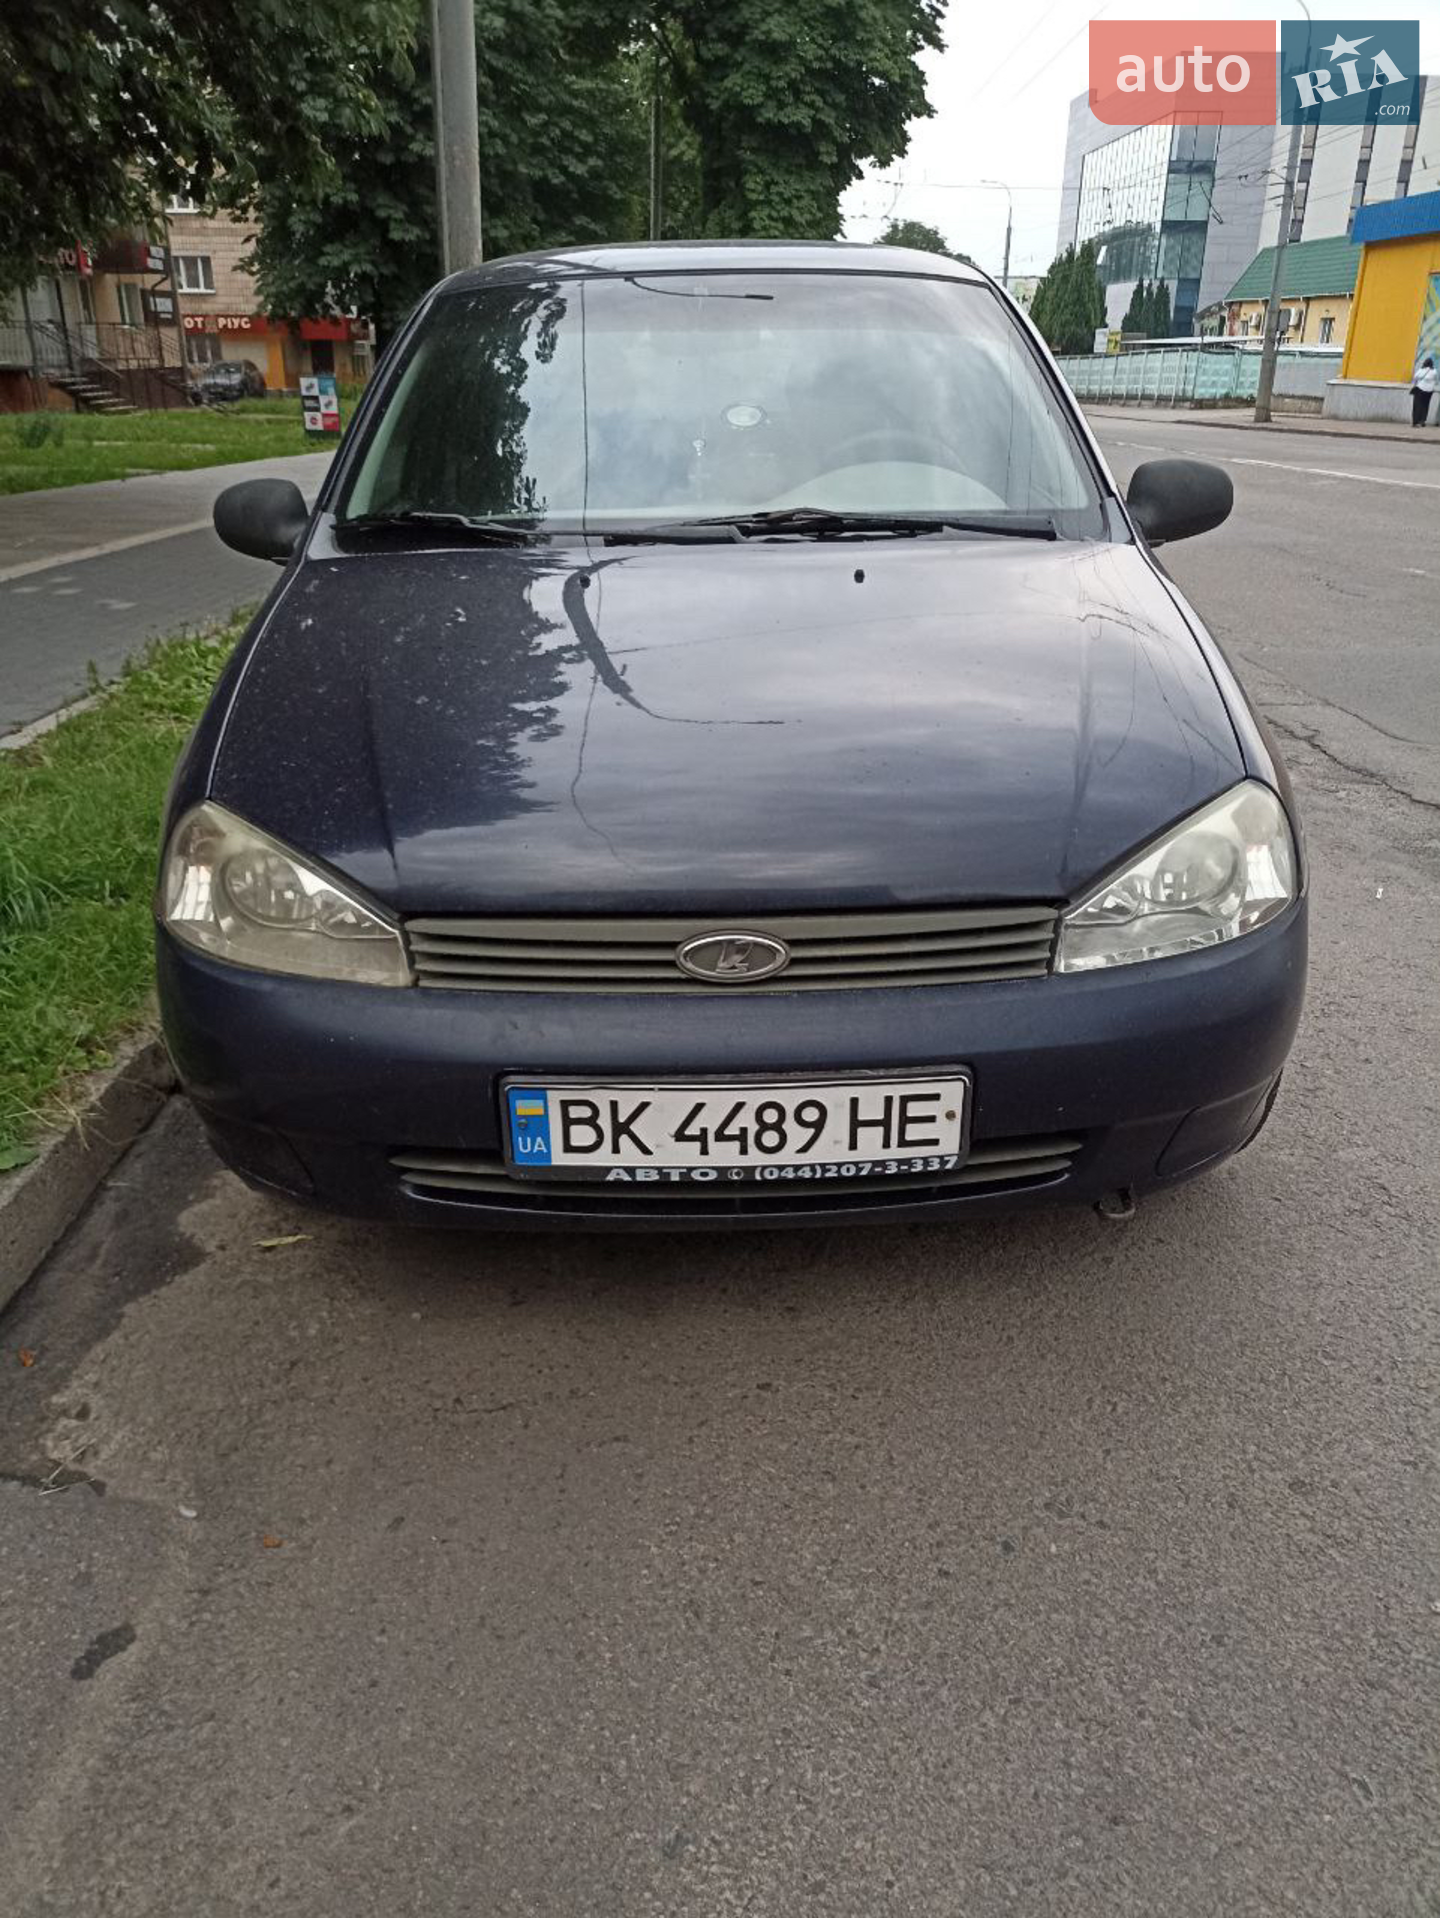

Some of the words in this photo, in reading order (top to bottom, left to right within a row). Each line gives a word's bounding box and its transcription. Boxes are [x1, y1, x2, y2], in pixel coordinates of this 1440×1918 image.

[559, 1099, 654, 1156] BK
[672, 1099, 828, 1156] 4489
[848, 1092, 942, 1152] HE
[518, 1136, 548, 1153] UA
[605, 1168, 718, 1181] АВТО
